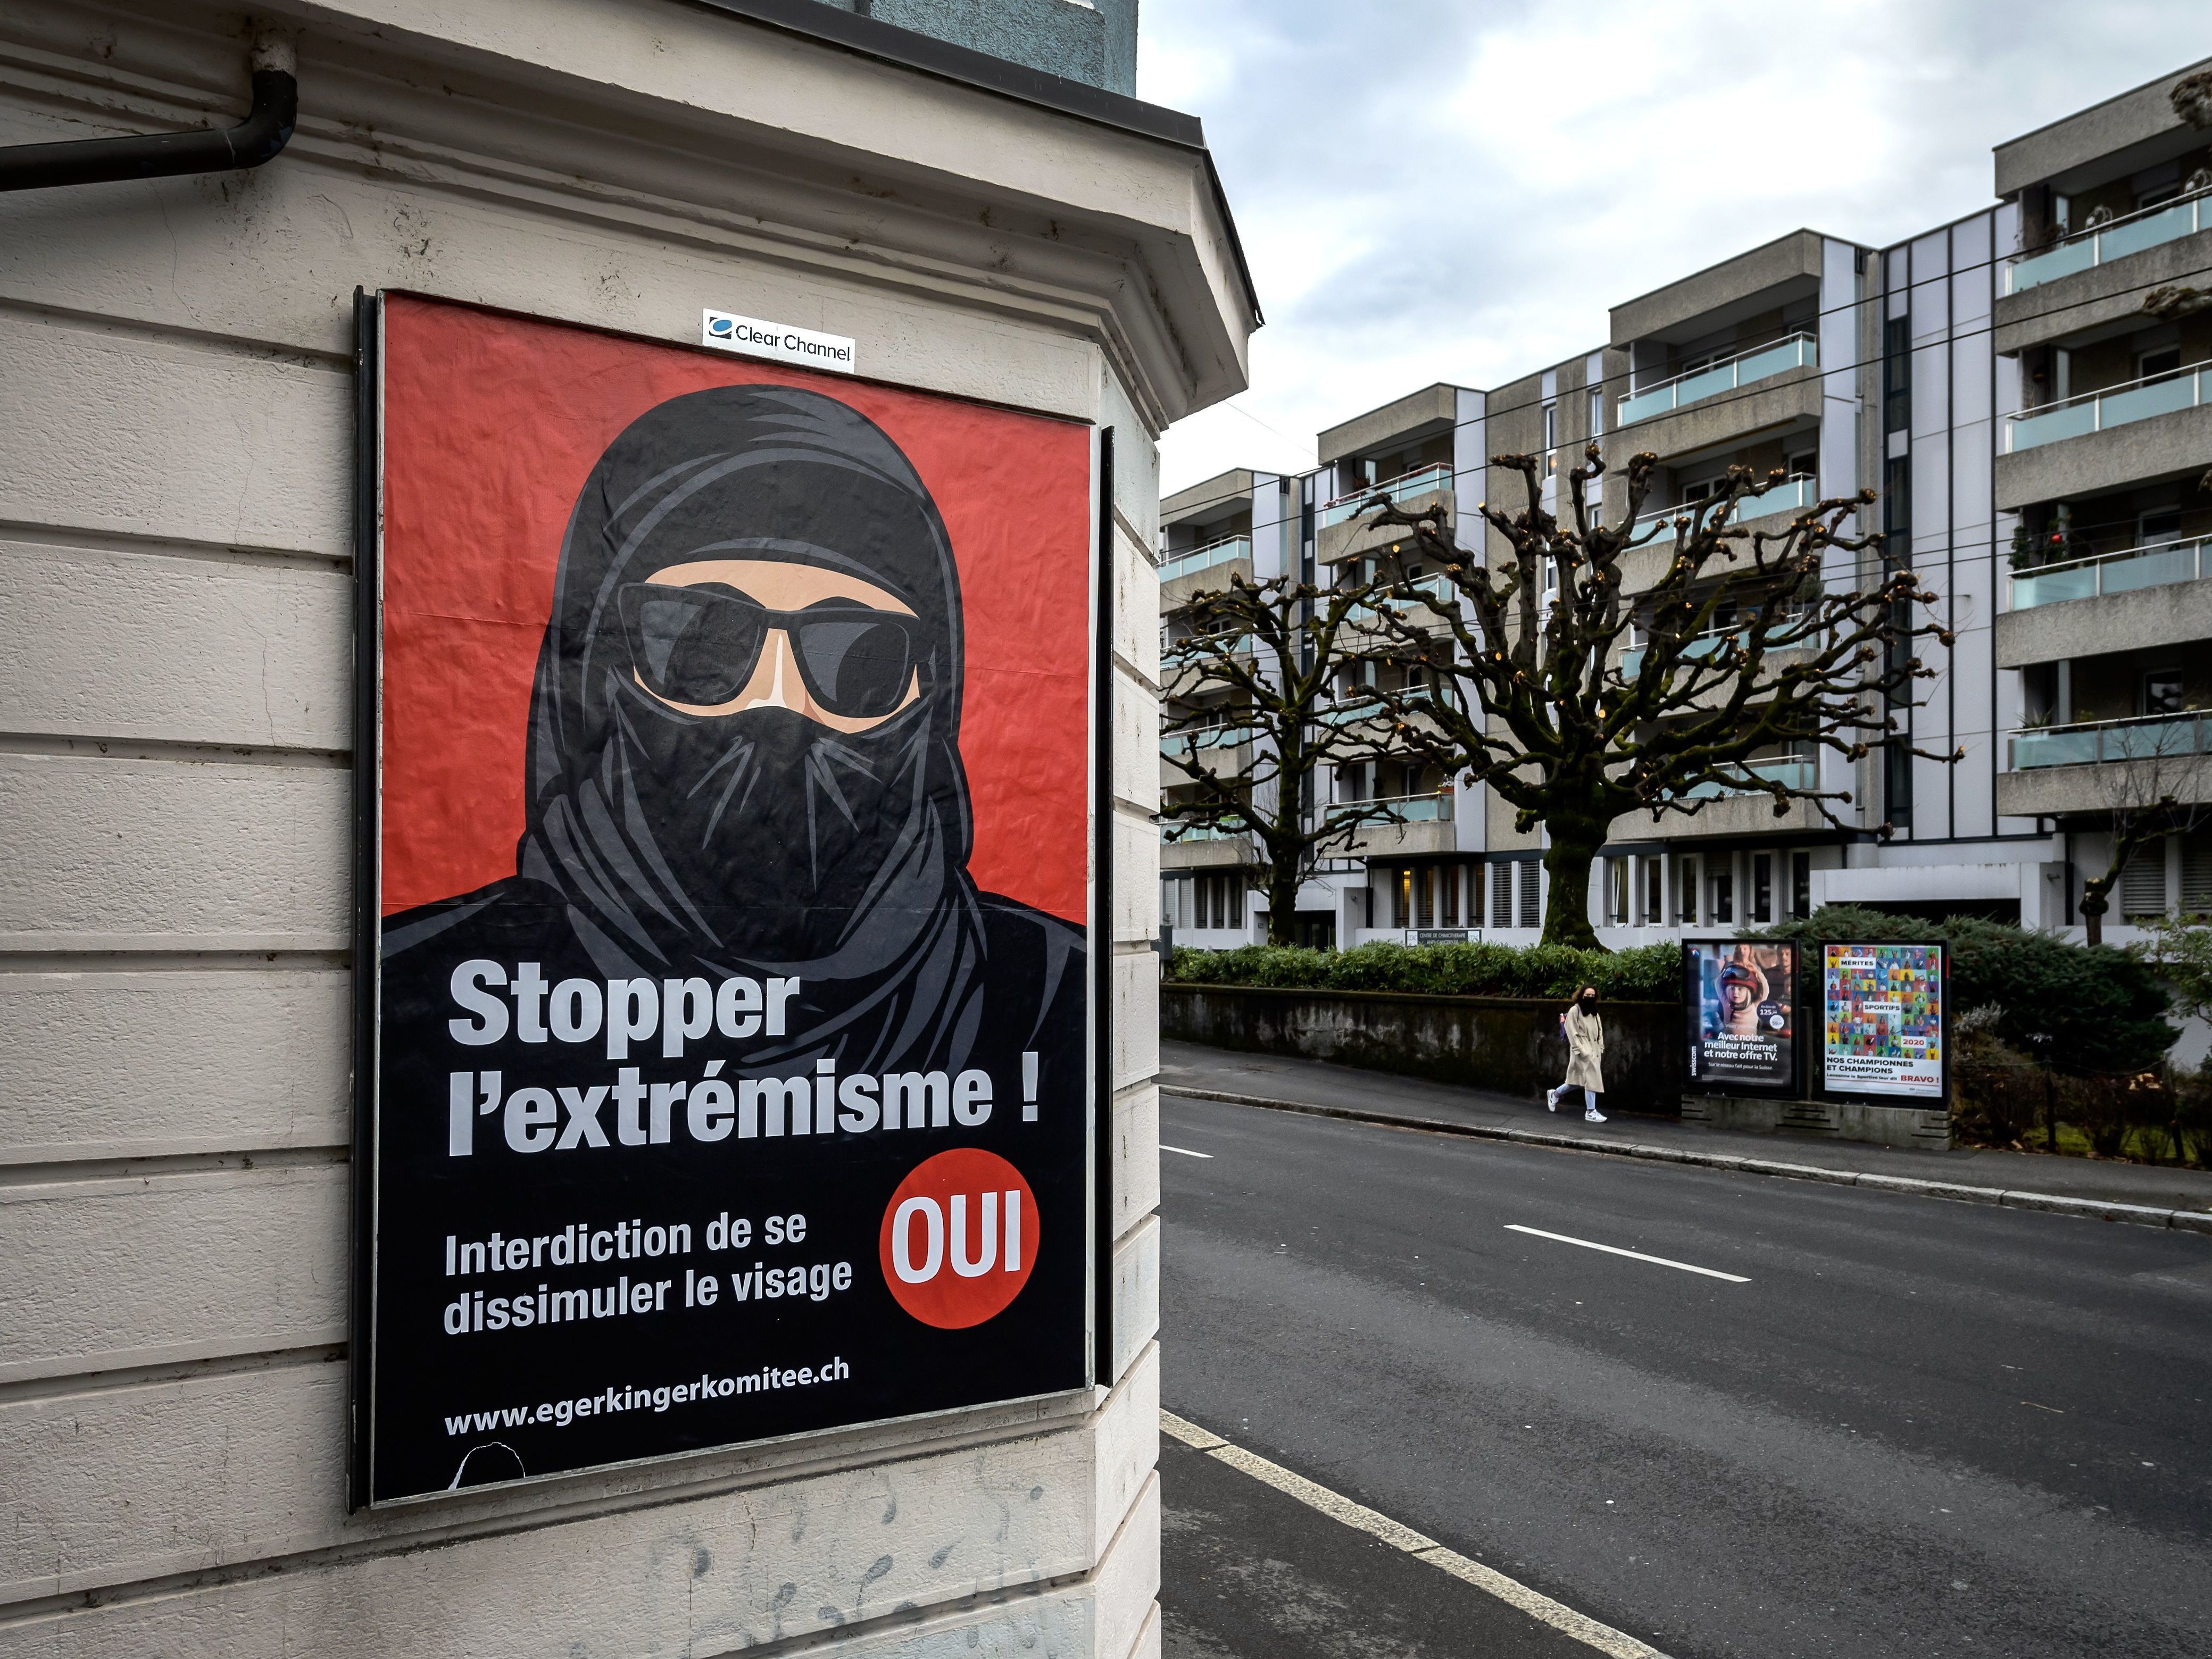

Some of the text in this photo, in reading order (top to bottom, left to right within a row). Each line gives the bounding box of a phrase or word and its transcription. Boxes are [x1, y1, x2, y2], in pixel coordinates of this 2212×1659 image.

[736, 325, 850, 362] Clear Channel
[448, 959, 800, 1060] Stopper
[1717, 1032, 1764, 1042] Avec notre
[1704, 1040, 1777, 1052] meilleur Internet
[1715, 1050, 1738, 1059] notre
[1740, 1051, 1762, 1060] offre
[1764, 1052, 1778, 1061] TV.
[1847, 1058, 1914, 1067] CHAMPIONNES
[1022, 1051, 1038, 1122] !
[446, 1212, 806, 1276] Interdiction de se
[892, 1189, 1020, 1284] OUI
[444, 1262, 852, 1335] dissimuler le visage
[444, 1356, 849, 1436] www.egerkingerkomitee.ch
